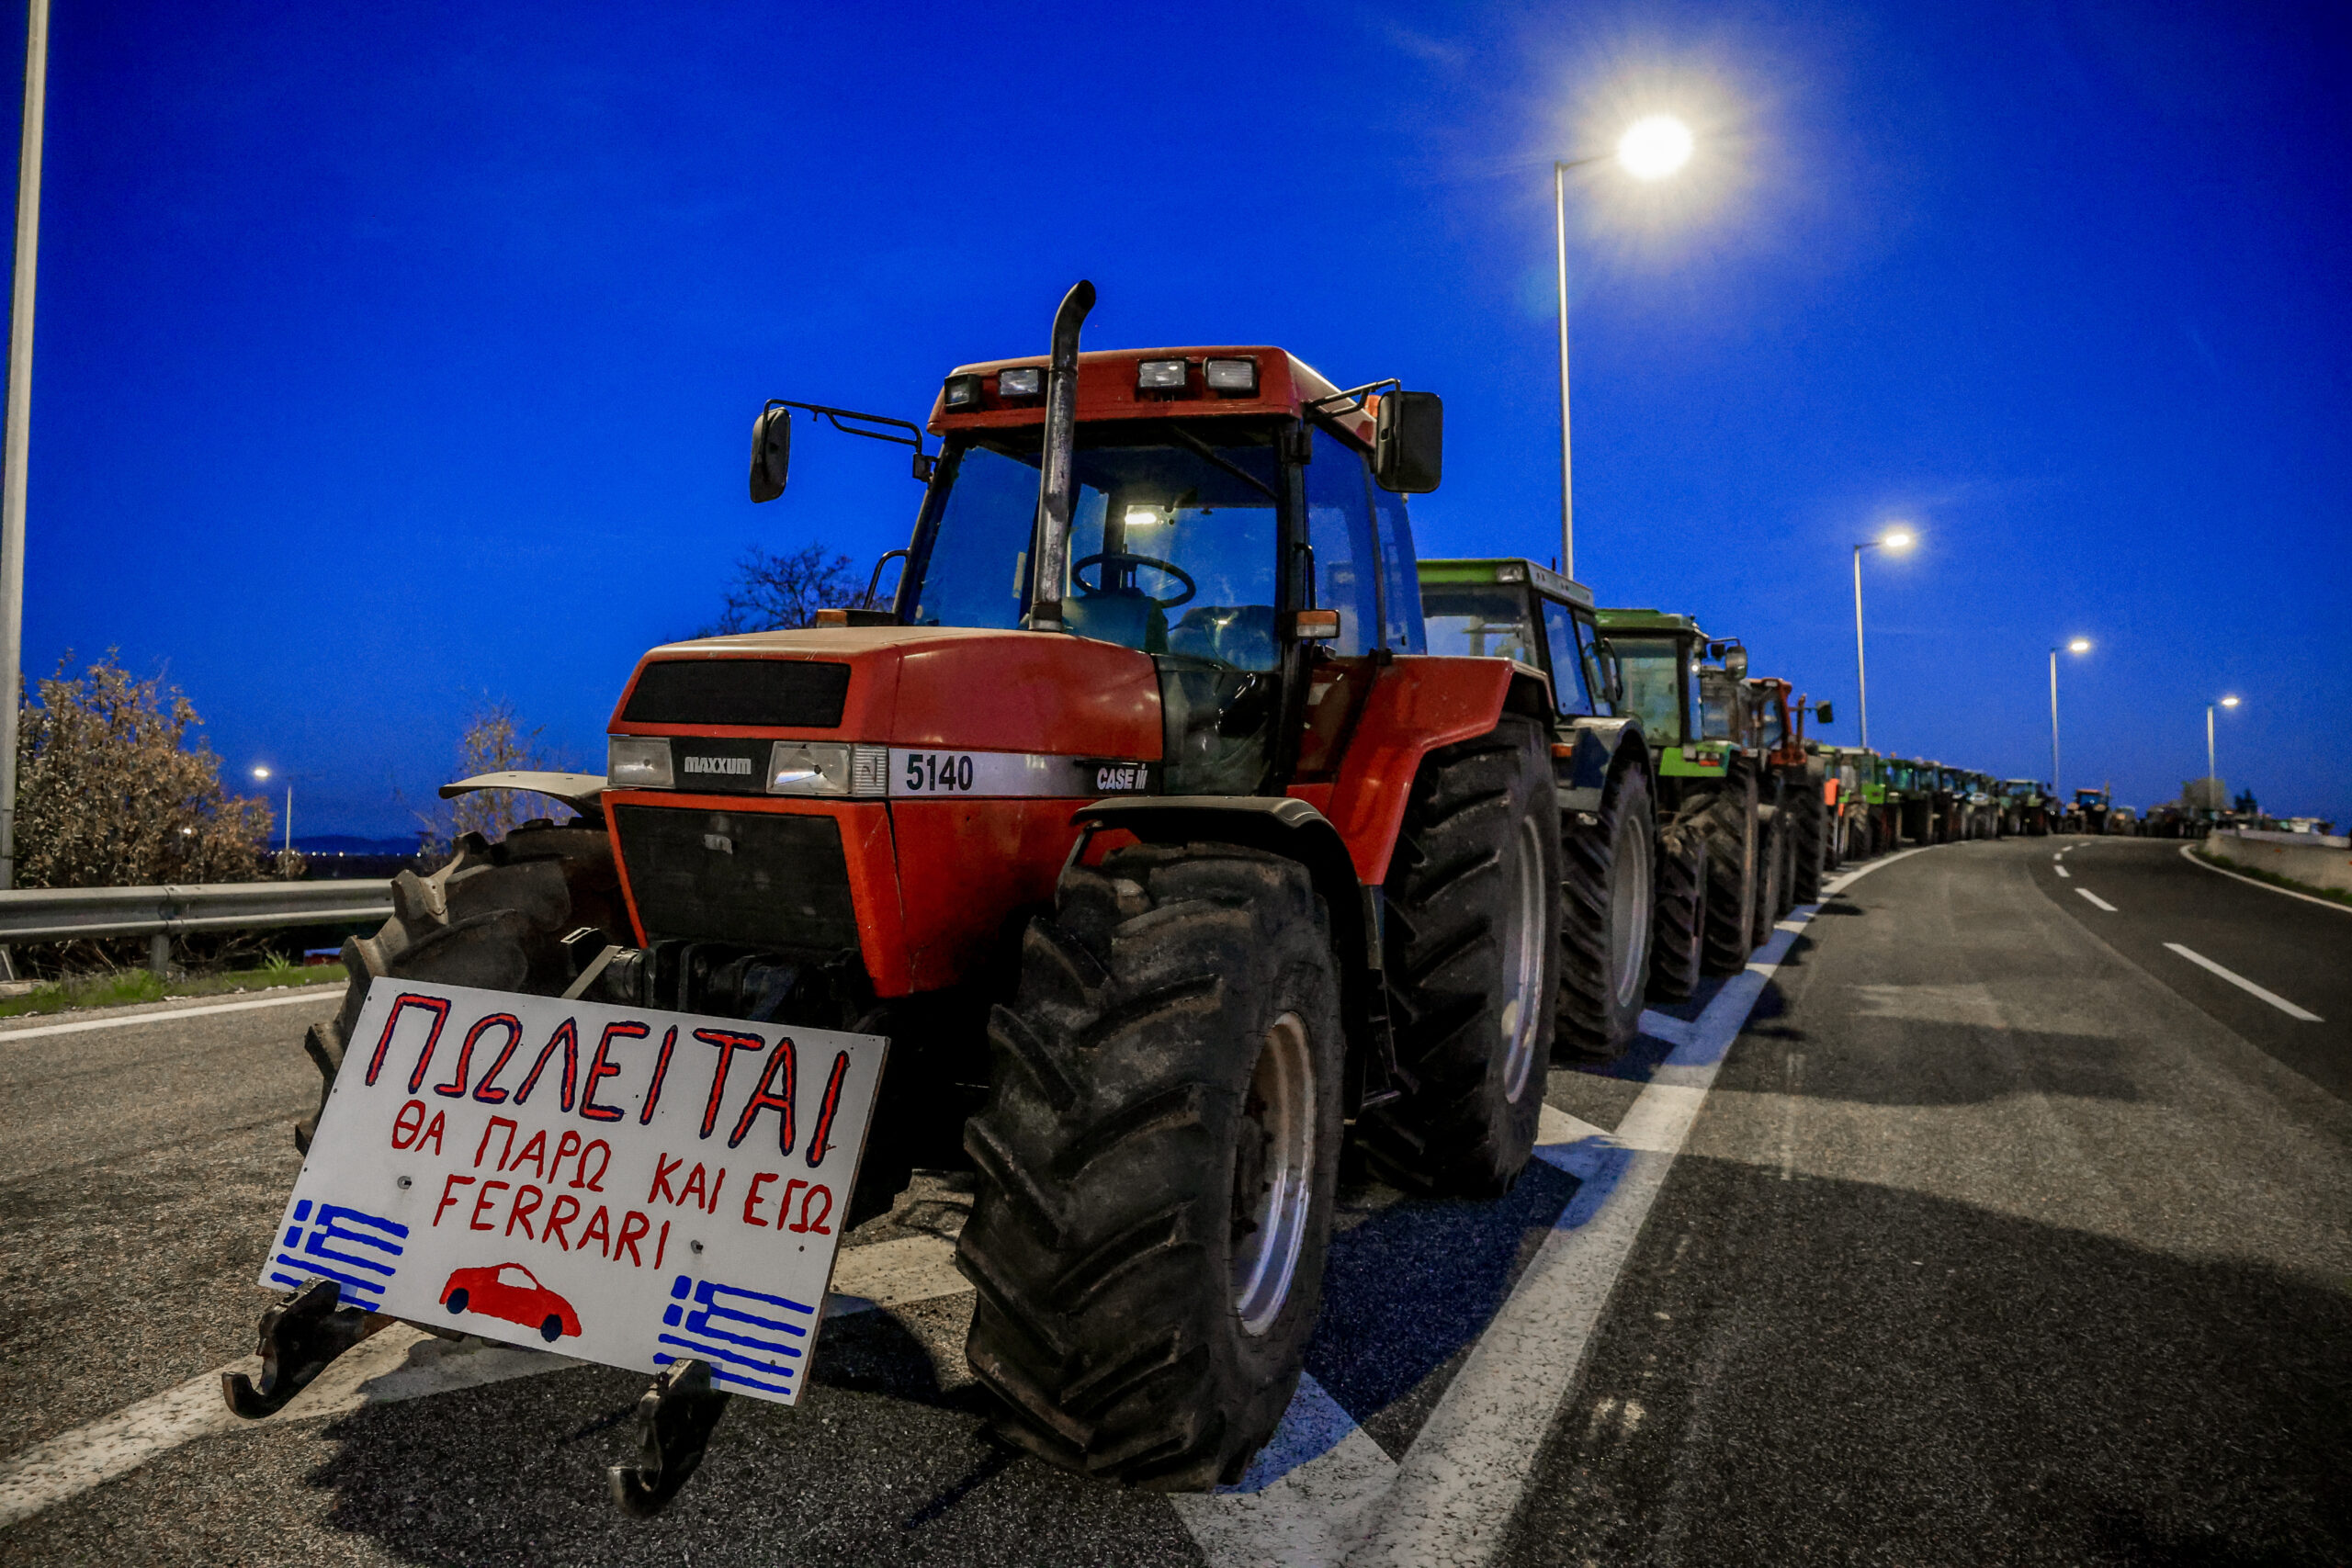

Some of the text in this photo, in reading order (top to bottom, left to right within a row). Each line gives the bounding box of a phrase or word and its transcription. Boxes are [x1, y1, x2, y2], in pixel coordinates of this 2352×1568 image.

[684, 756, 752, 775] MAXXUM
[906, 754, 973, 791] 5140
[1097, 767, 1135, 790] CASE
[365, 992, 850, 1168] ΠΩΛΕΙΤΑΙ
[391, 1099, 832, 1235] ΘΑ ΠΑΡΩ ΚΑΙ ΕΓΩ
[433, 1173, 672, 1271] FERRARI
